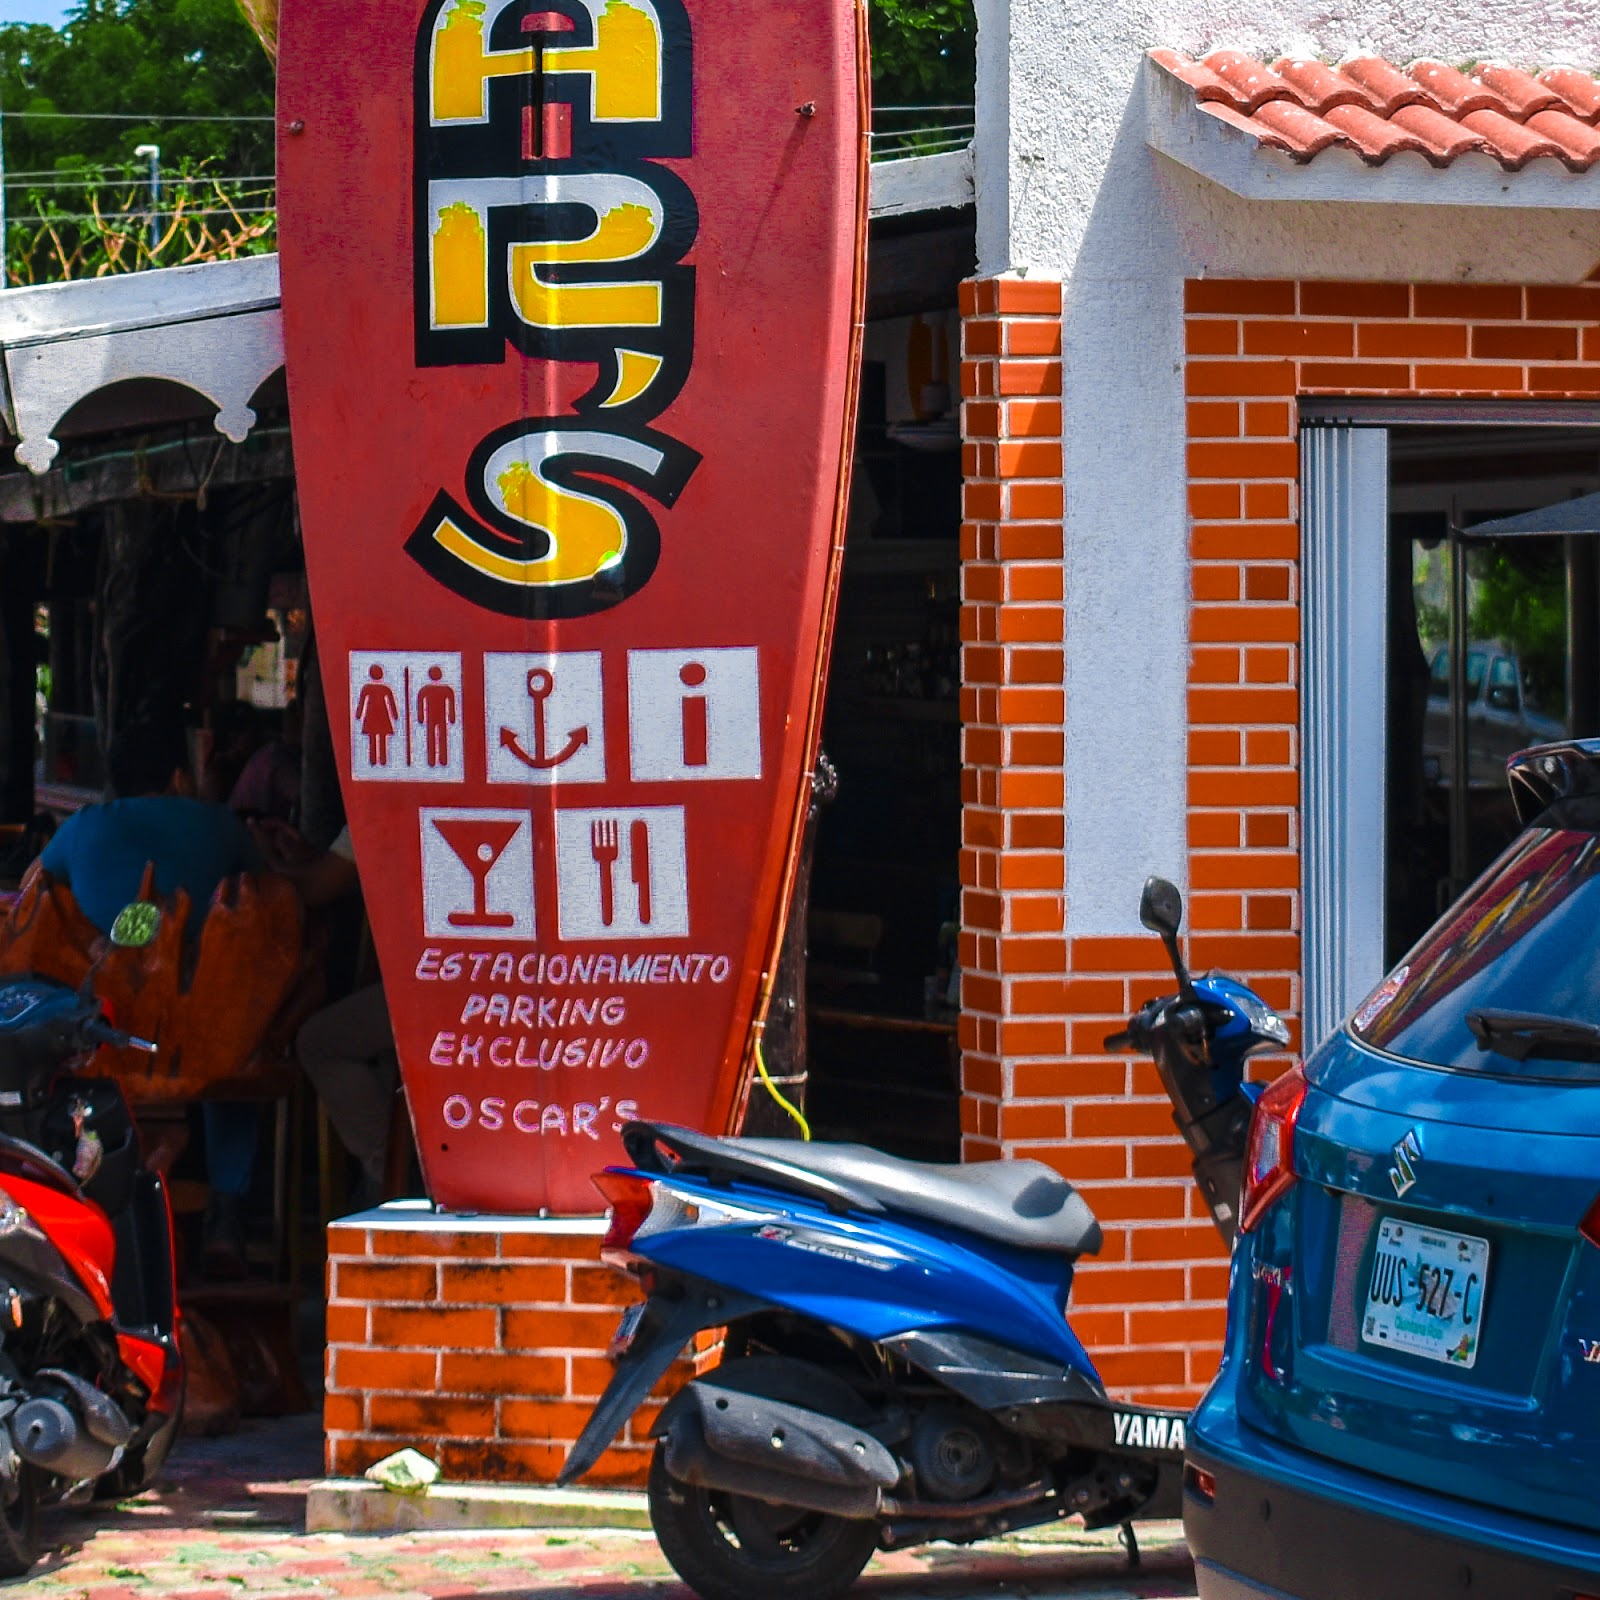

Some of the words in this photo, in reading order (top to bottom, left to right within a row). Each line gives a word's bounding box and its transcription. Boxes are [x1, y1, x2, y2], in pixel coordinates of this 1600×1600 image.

[415, 947, 731, 984] ESTACIONAMIENTO
[460, 994, 626, 1029] PARKING
[429, 1032, 649, 1069] EXCLUSIVO
[442, 1093, 640, 1141] OSCAR'S
[1113, 1412, 1186, 1450] YAMA
